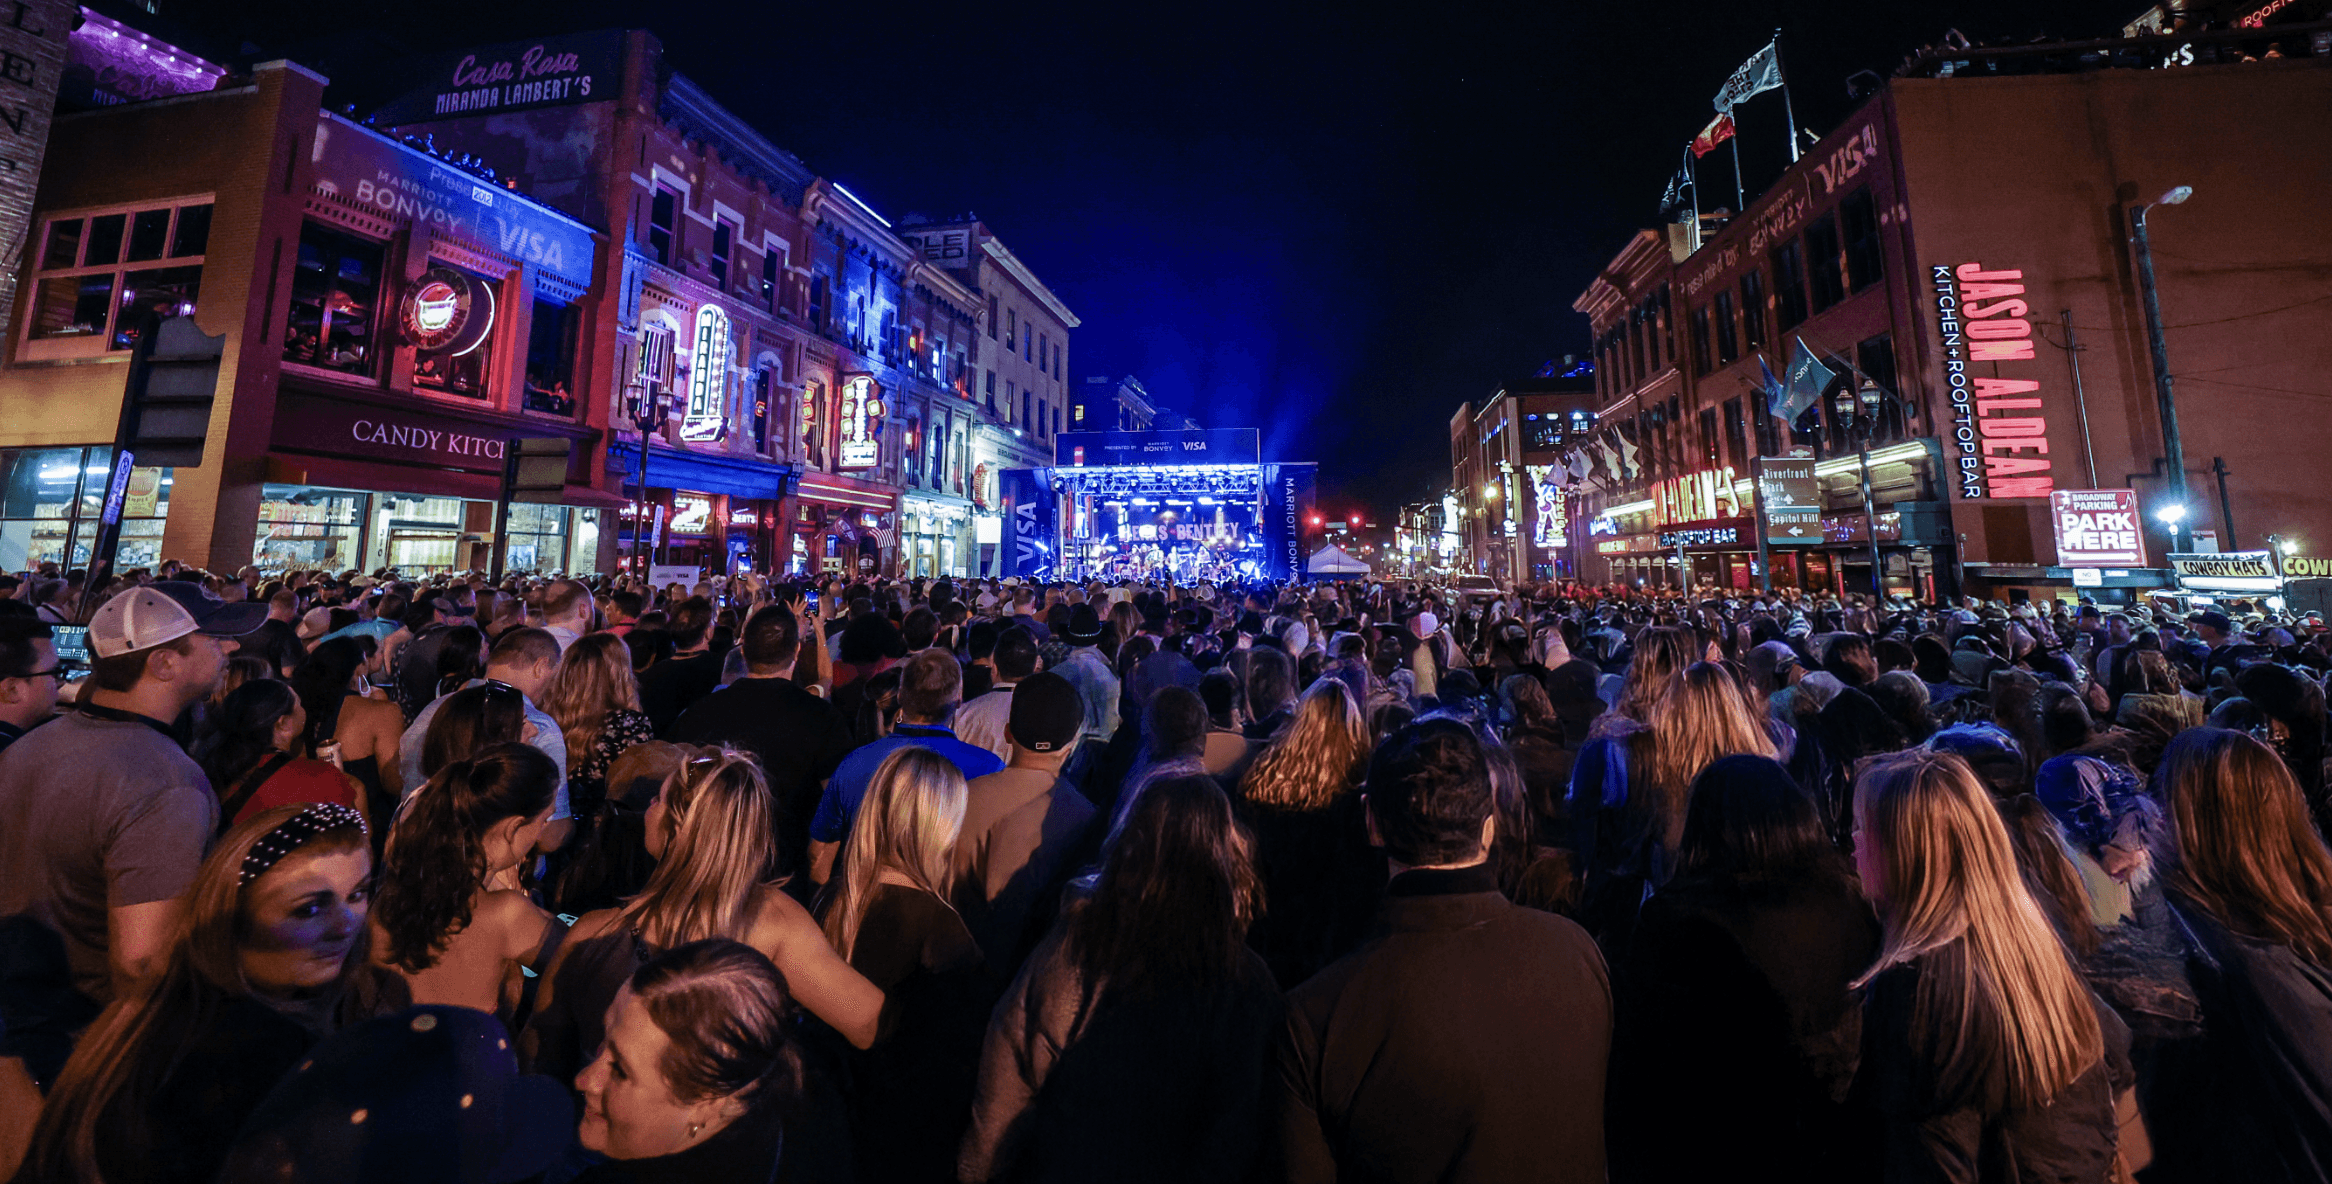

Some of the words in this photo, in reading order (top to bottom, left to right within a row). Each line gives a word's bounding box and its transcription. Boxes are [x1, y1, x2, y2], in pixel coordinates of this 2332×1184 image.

[453, 54, 514, 87] Casa
[519, 44, 579, 80] Rosa
[436, 87, 499, 114] MIRANDA
[504, 75, 591, 105] LAMBERT'S
[1814, 122, 1877, 194] VISA
[356, 178, 462, 234] BONVOY
[377, 170, 453, 206] MARRIOTT
[474, 189, 492, 204] 2012
[494, 215, 563, 271] VISA
[1956, 262, 2036, 362] JASON
[693, 313, 713, 411] MIRANDA
[353, 420, 442, 451] CANDY
[447, 433, 505, 459] KITC
[1181, 441, 1207, 451] VISA
[1973, 377, 2054, 499] ALDEAN
[1763, 468, 1809, 479] Riverfront
[1285, 477, 1296, 537] MARRIOTT
[2072, 493, 2117, 501] BROADWAY
[2073, 501, 2118, 510] PARKING
[1016, 501, 1037, 567] VISA
[1712, 527, 1737, 544] BAR
[1768, 513, 1800, 525] Capitol
[1802, 513, 1819, 523] Hill
[2061, 512, 2135, 531] PARK
[2063, 531, 2138, 550] HERE
[1288, 540, 1298, 582] BONVO
[2183, 561, 2231, 576] COWBOY
[2231, 561, 2267, 576] HATS
[2282, 558, 2332, 576] COW
